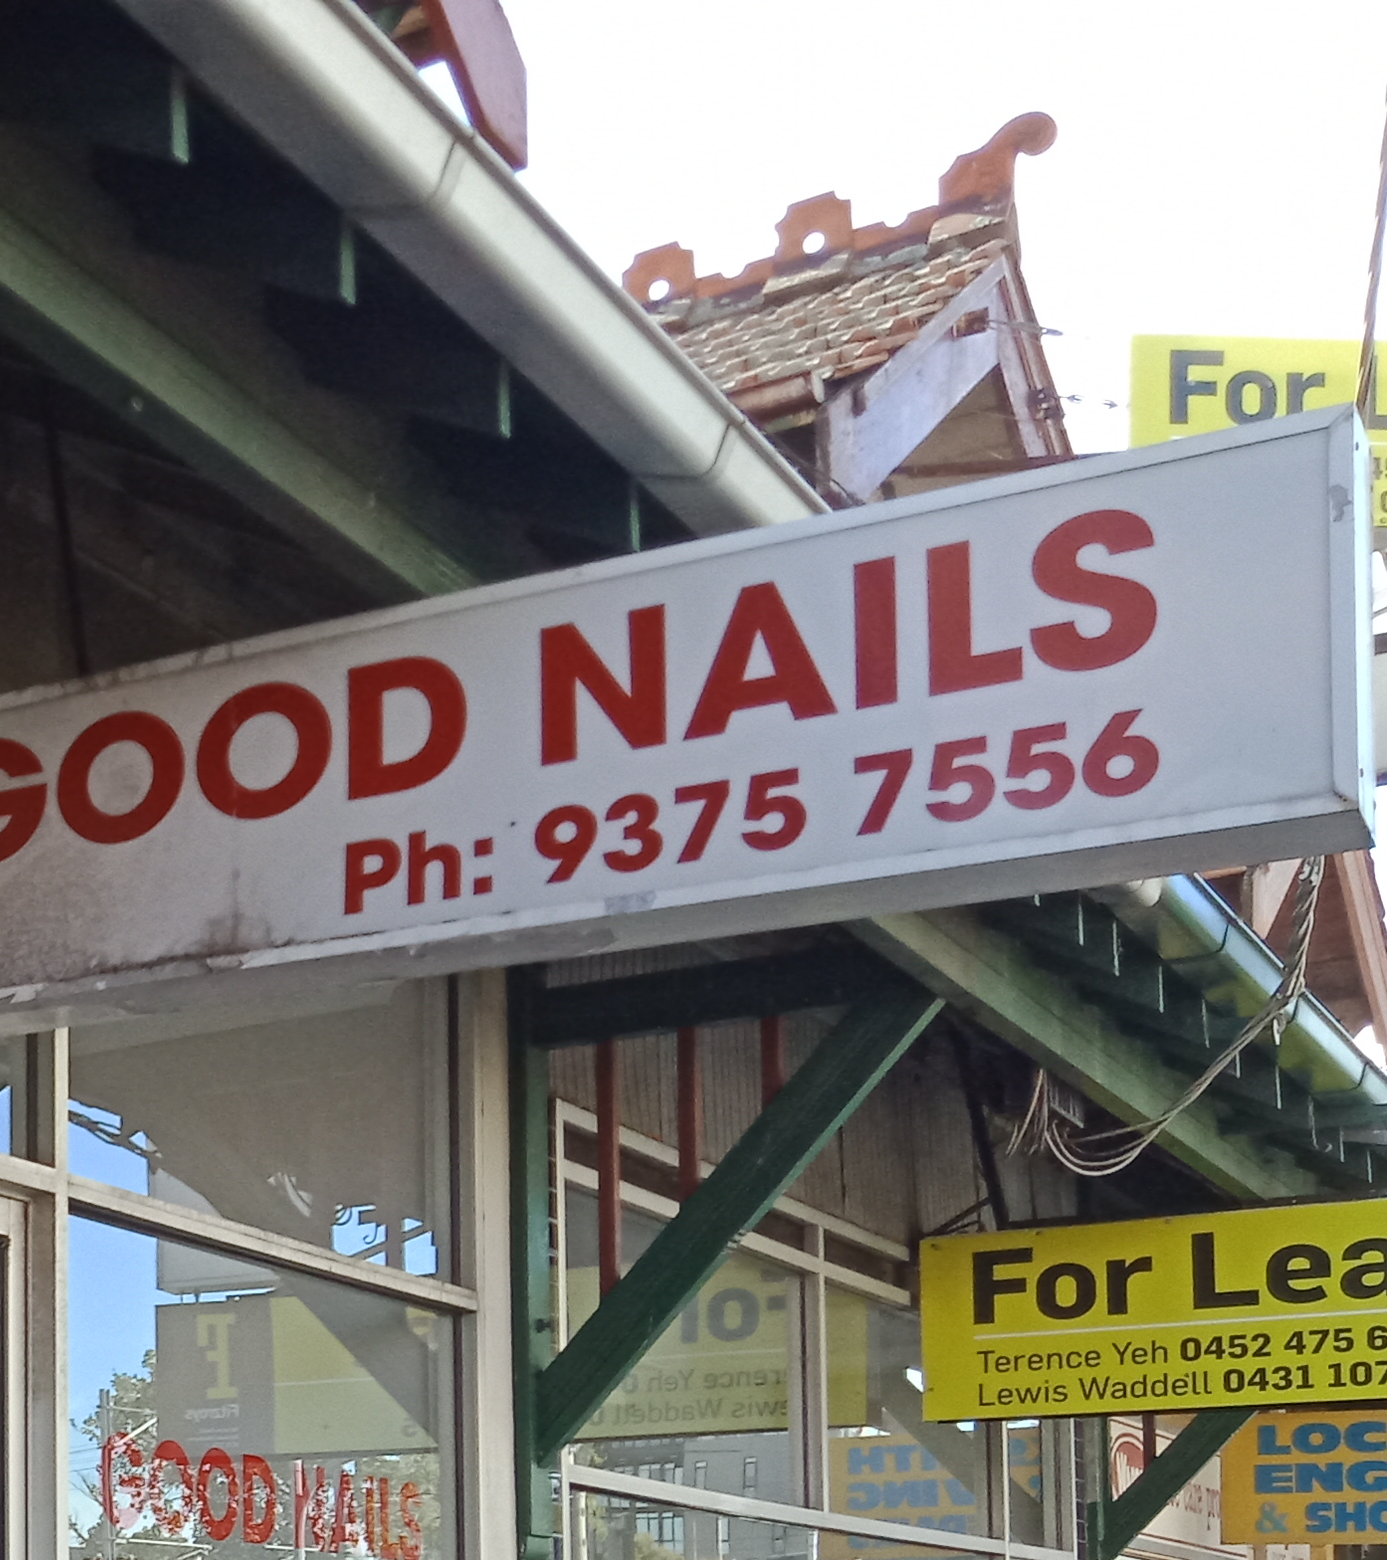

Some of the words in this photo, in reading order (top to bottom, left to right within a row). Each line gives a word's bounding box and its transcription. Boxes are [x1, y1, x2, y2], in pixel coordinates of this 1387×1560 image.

[1170, 350, 1326, 426] For
[540, 508, 1159, 766] NAILS
[343, 831, 494, 917] Ph:
[535, 766, 807, 882] 9375
[855, 709, 1161, 838] 7556
[972, 1246, 1153, 1325] For
[978, 1346, 1102, 1374] Terence
[1111, 1339, 1169, 1367] Yeh
[1180, 1333, 1273, 1362] 0452
[1284, 1327, 1355, 1356] 475
[978, 1382, 1069, 1407] Lewis
[1077, 1371, 1213, 1402] Waddell
[1223, 1364, 1315, 1394] 0431
[1257, 1421, 1387, 1456] LOC
[1253, 1461, 1387, 1494] ENG
[1255, 1501, 1288, 1534] &
